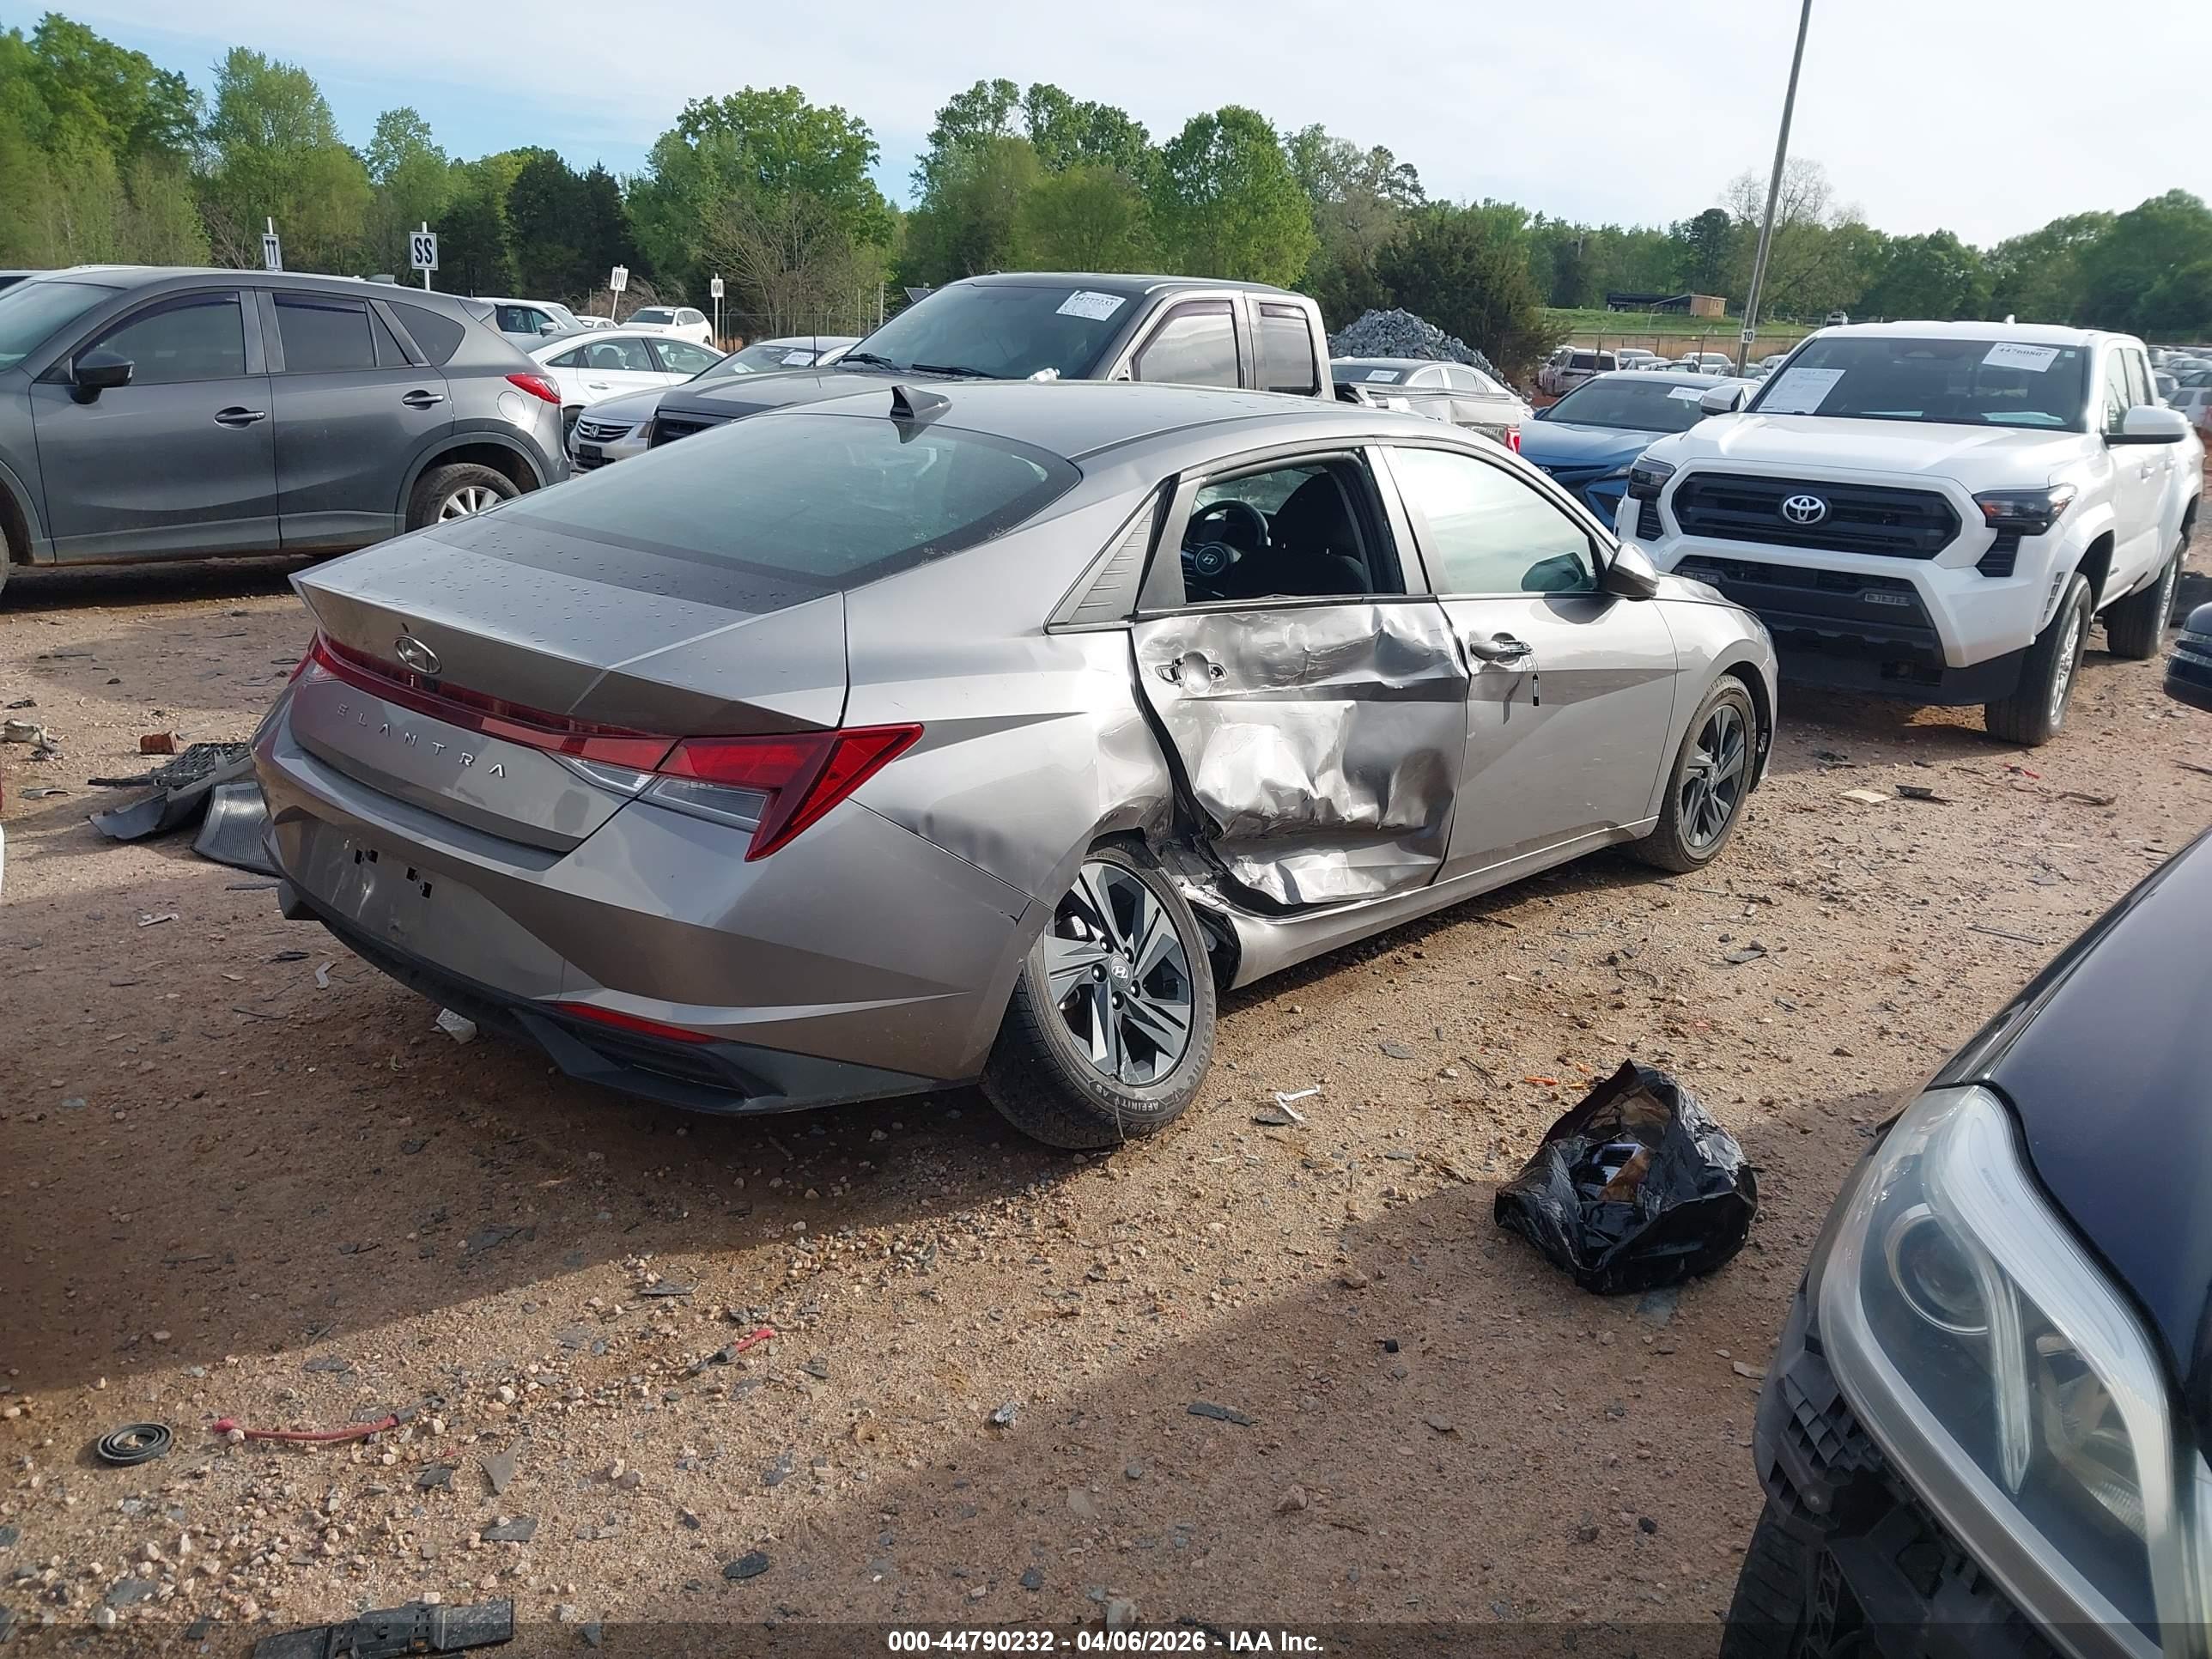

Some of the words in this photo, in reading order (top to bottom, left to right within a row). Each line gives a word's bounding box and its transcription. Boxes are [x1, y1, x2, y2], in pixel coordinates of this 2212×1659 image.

[265, 240, 277, 265] TT
[414, 236, 434, 264] SS
[1743, 331, 1753, 342] 10
[337, 703, 506, 778] ELANTRA
